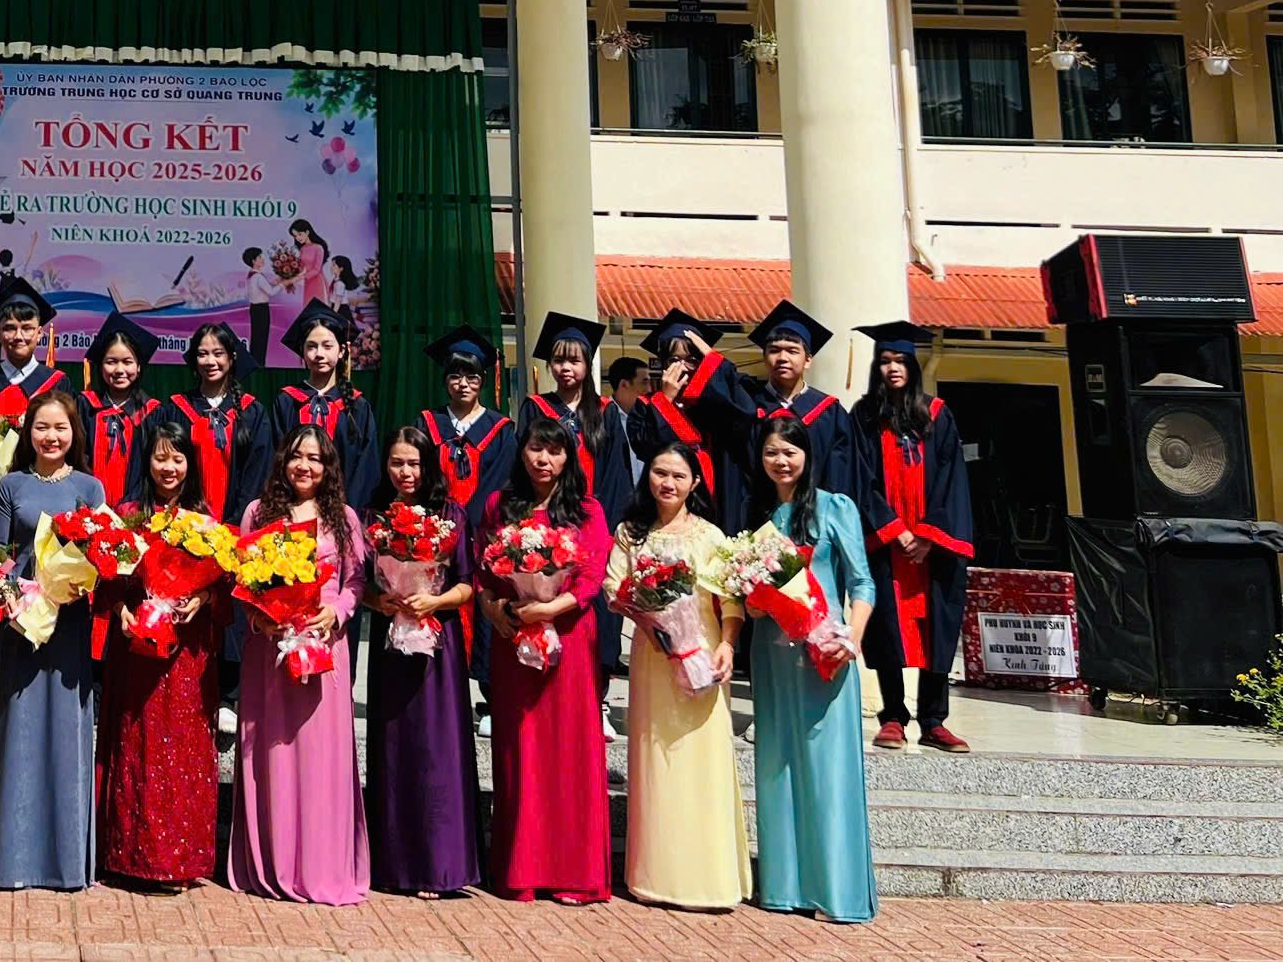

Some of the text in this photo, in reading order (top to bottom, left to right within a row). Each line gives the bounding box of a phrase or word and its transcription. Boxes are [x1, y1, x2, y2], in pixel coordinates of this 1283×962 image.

[37, 73, 64, 83] BAN
[198, 76, 206, 86] 2
[60, 87, 106, 98] TRUNG
[108, 88, 137, 101] HỌC
[140, 88, 160, 100] CƠ
[164, 86, 183, 100] SỞ
[186, 89, 233, 101] QUANG
[237, 91, 283, 102] TRUNG
[34, 111, 249, 152] TỔNG KẾT
[20, 154, 264, 183] NĂM HỌC 2025-2026
[16, 194, 42, 212] RA
[45, 190, 129, 215] TRƯỜNG
[134, 196, 177, 220] HỌC
[180, 197, 227, 218] SINH
[232, 195, 282, 219] KHỐI
[286, 200, 298, 219] 9
[51, 223, 232, 246] NIÊN KHOÁ 2022-2026
[62, 333, 70, 347] 2
[71, 332, 91, 348] Bảo
[158, 336, 187, 352] tháng
[1048, 620, 1065, 630] SINH
[1032, 633, 1037, 642] 9
[1024, 645, 1042, 656] 2022
